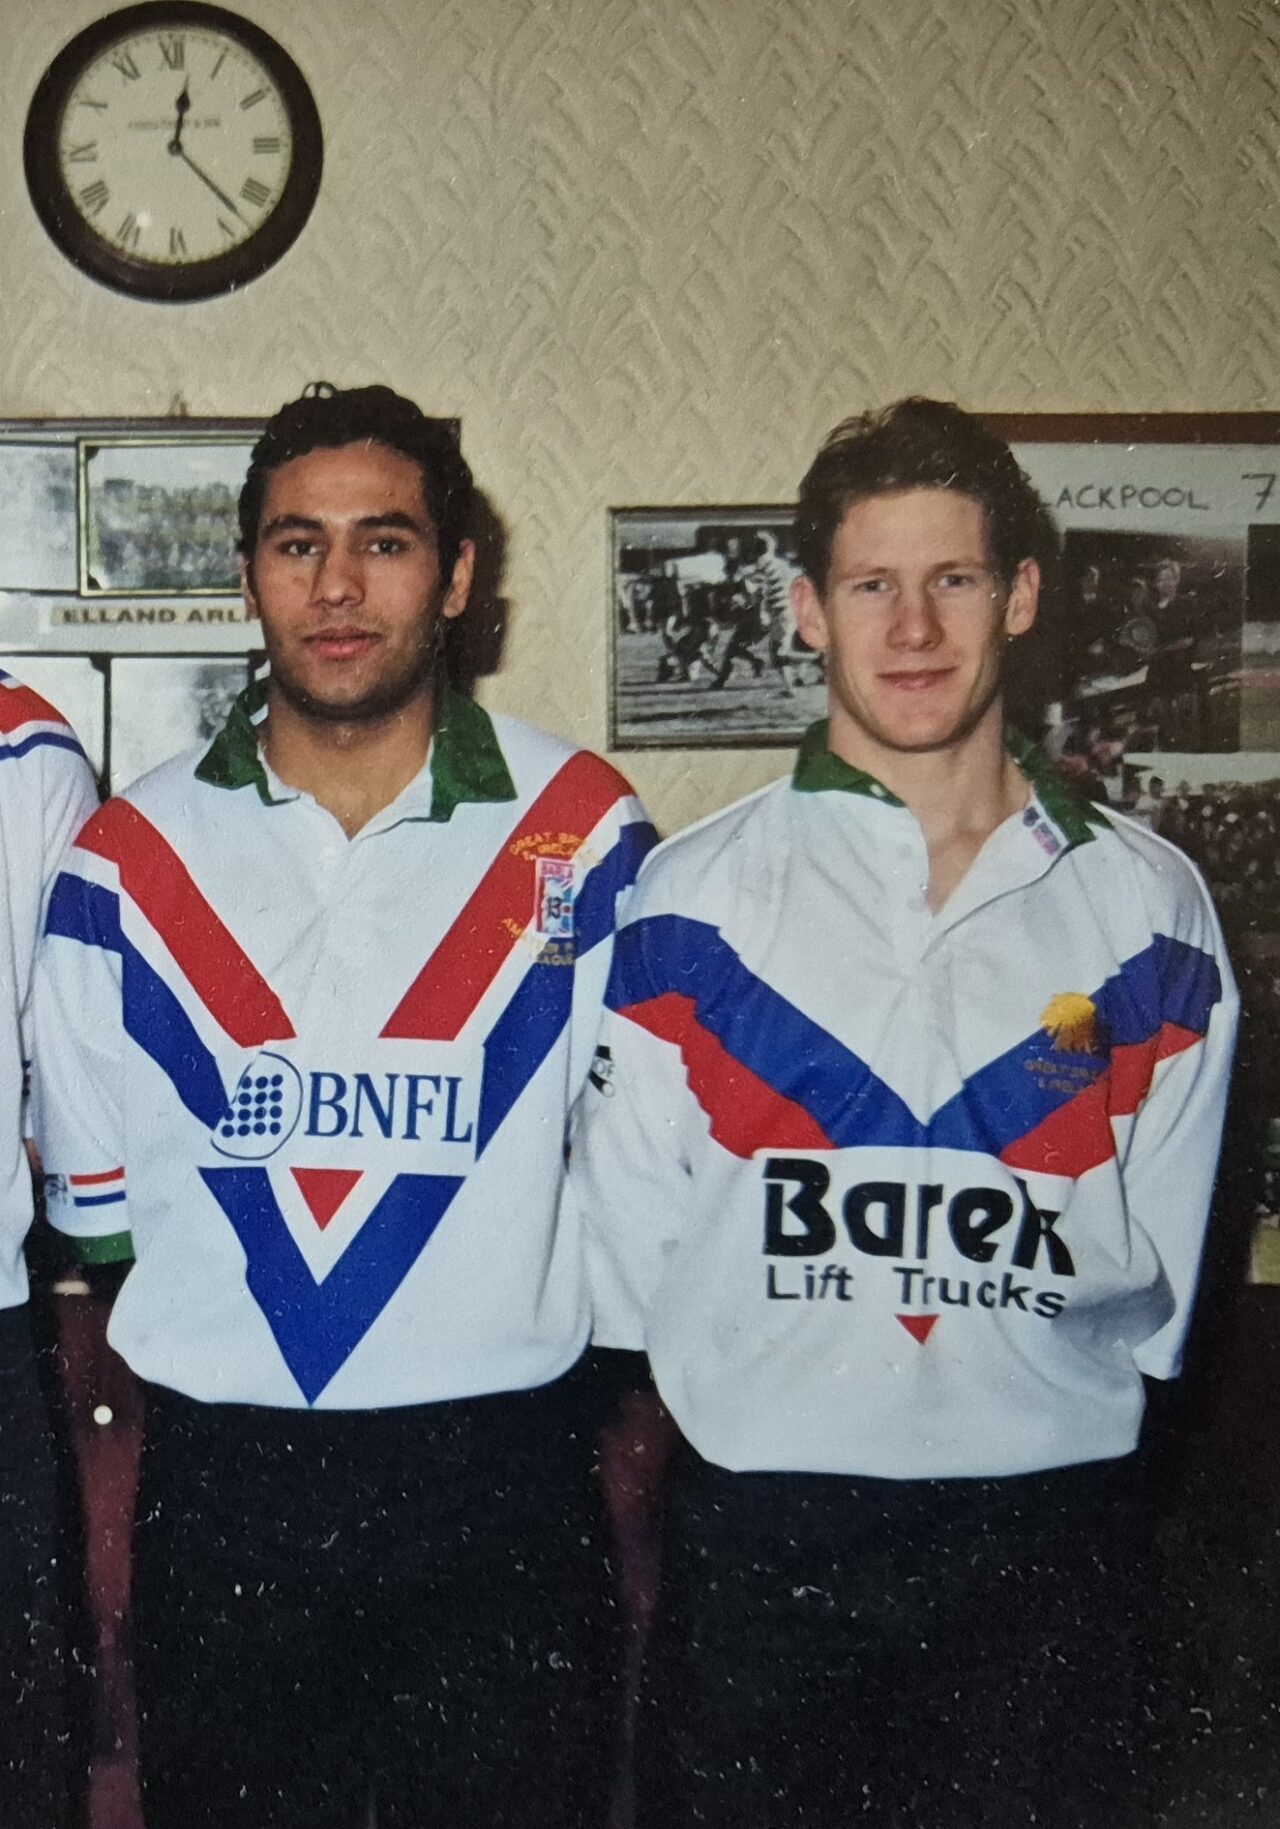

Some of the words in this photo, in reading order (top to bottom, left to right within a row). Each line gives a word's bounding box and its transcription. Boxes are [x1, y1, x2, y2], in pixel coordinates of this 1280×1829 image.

[1042, 484, 1209, 510] ACKPOOL
[63, 607, 176, 624] ELLAND
[304, 1071, 473, 1143] BNFL
[762, 1157, 1076, 1277] Barek
[766, 1264, 854, 1301] Lift
[892, 1266, 1066, 1319] Trucks
